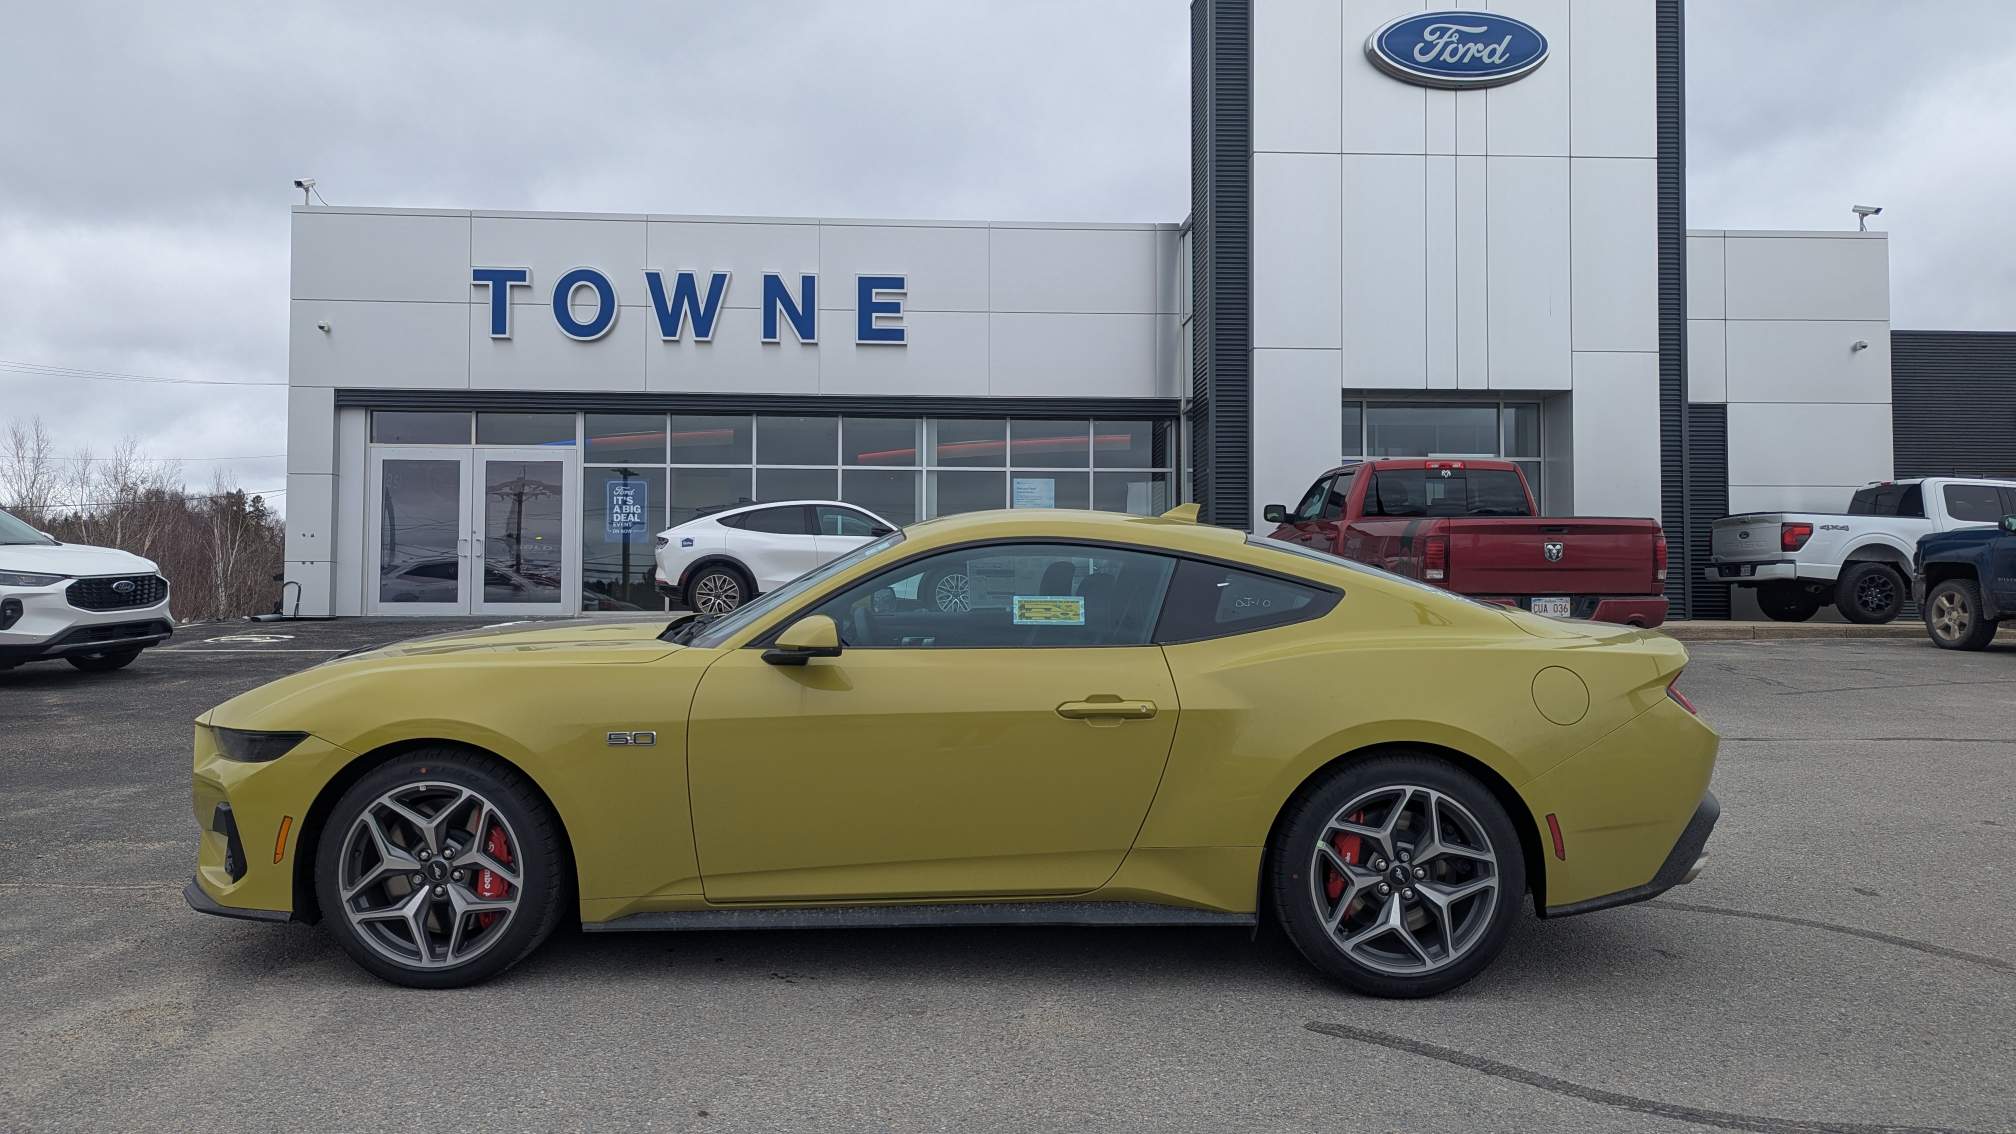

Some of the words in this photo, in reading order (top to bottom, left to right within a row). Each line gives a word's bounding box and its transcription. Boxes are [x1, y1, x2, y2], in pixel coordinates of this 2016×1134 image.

[1413, 23, 1512, 64] Ford
[471, 266, 908, 345] TOWNE
[613, 486, 635, 496] Ford
[613, 496, 634, 505] IT'S
[613, 505, 621, 514] A
[622, 505, 642, 514] BIG
[613, 513, 641, 522] DEAL
[1533, 603, 1549, 614] CUA
[1553, 603, 1569, 613] 036
[607, 731, 657, 745] 5.0
